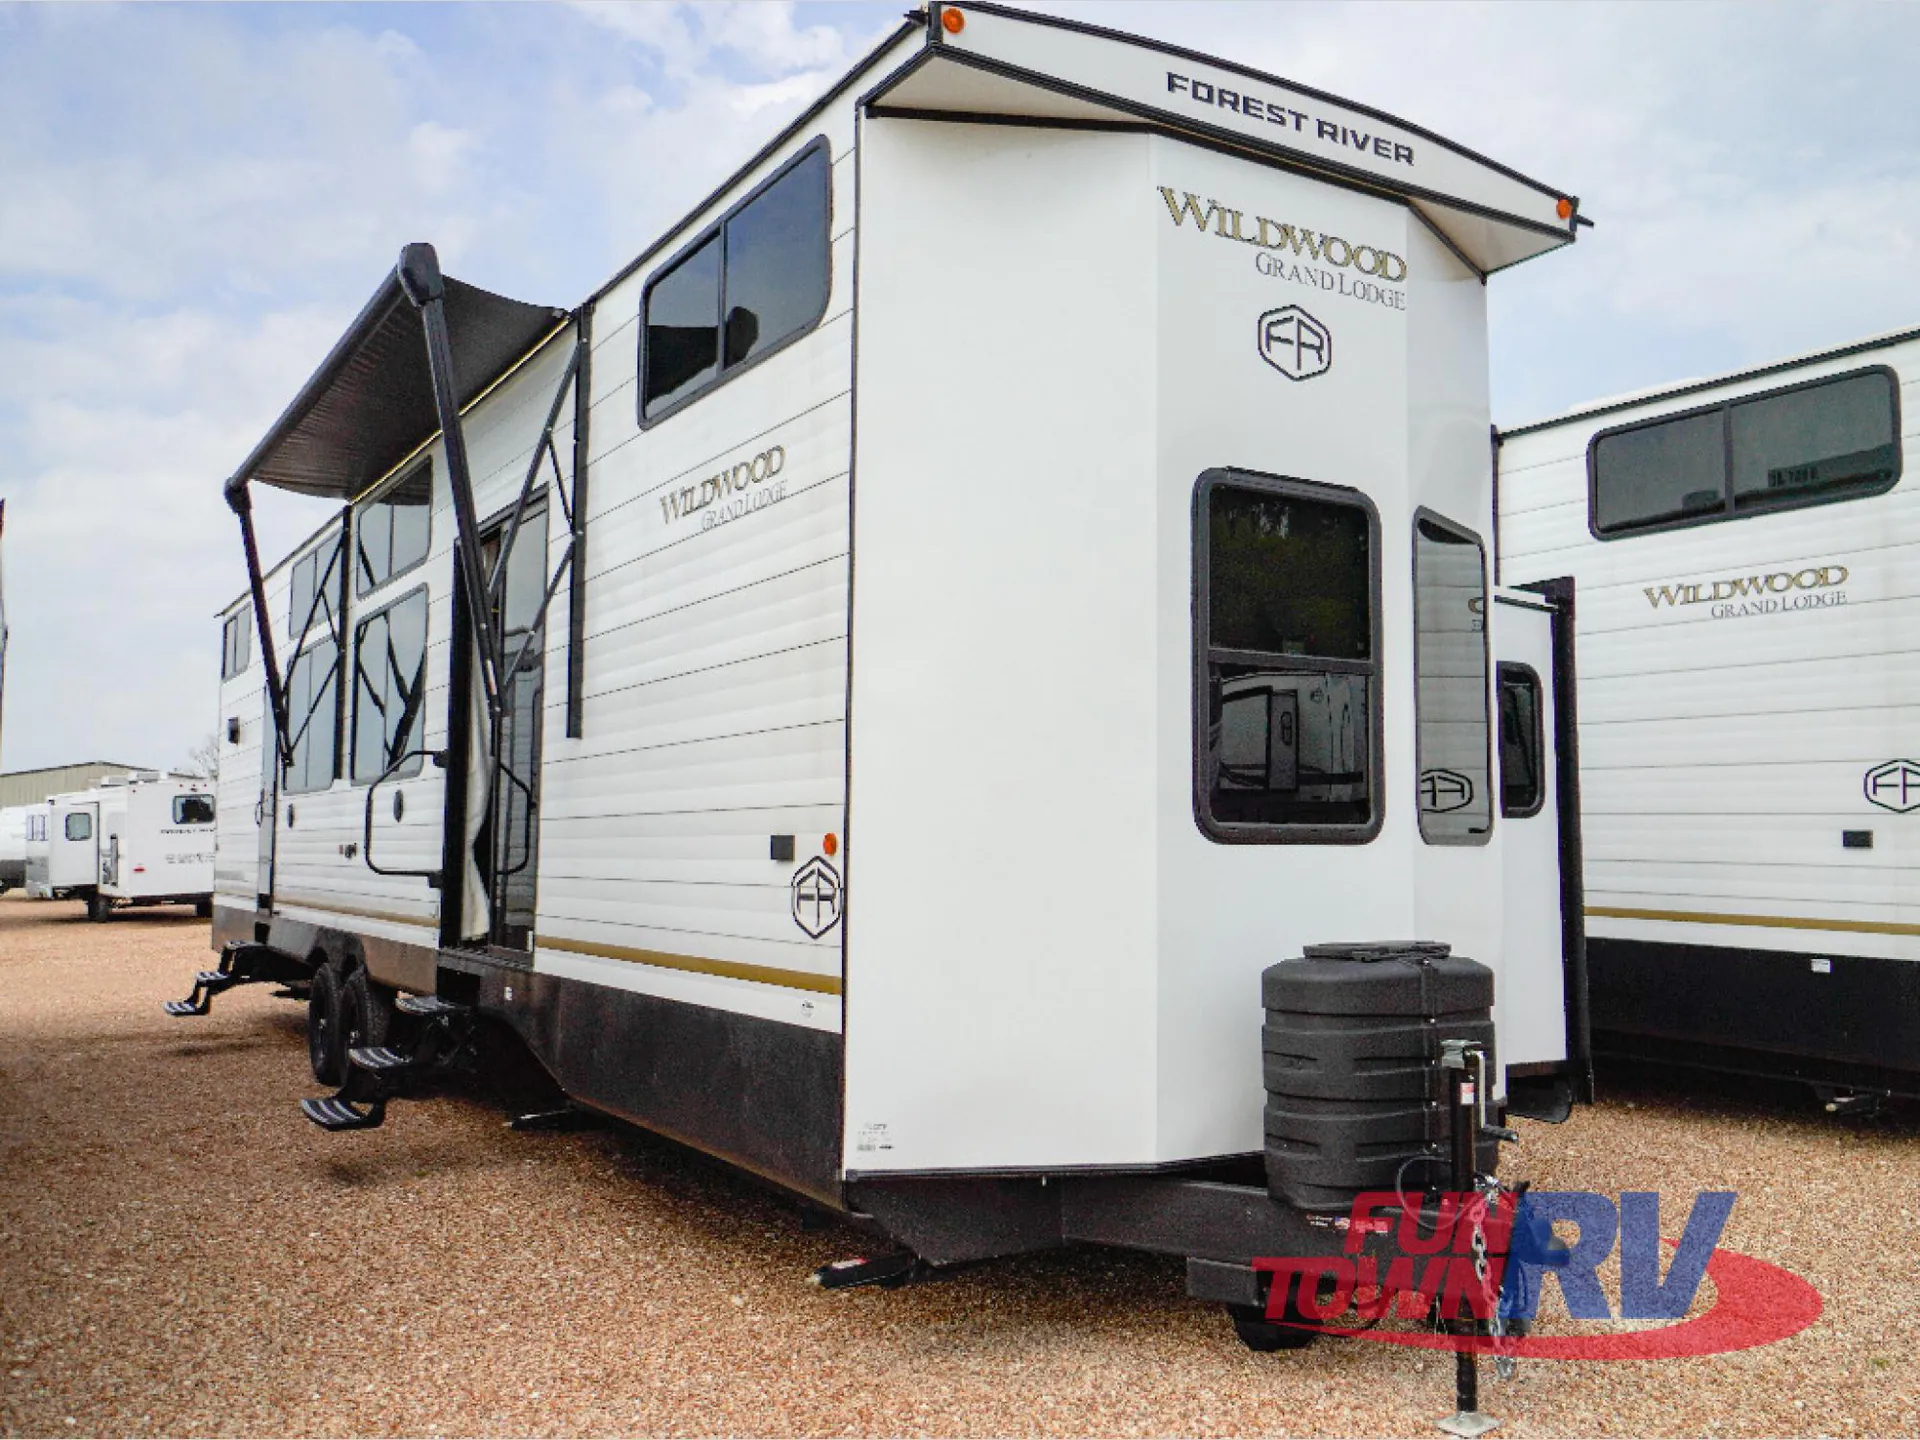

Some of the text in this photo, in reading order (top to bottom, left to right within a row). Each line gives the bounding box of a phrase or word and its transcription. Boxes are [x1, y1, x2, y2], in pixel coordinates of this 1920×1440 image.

[1167, 71, 1415, 167] FOREST RIVER
[1156, 185, 1407, 283] WILDWOOD
[1255, 251, 1406, 311] GRAND LODGE
[659, 443, 786, 526] WILDWOOD
[1643, 564, 1850, 610] WILDWOOD
[1710, 590, 1849, 621] GRAND LODGE
